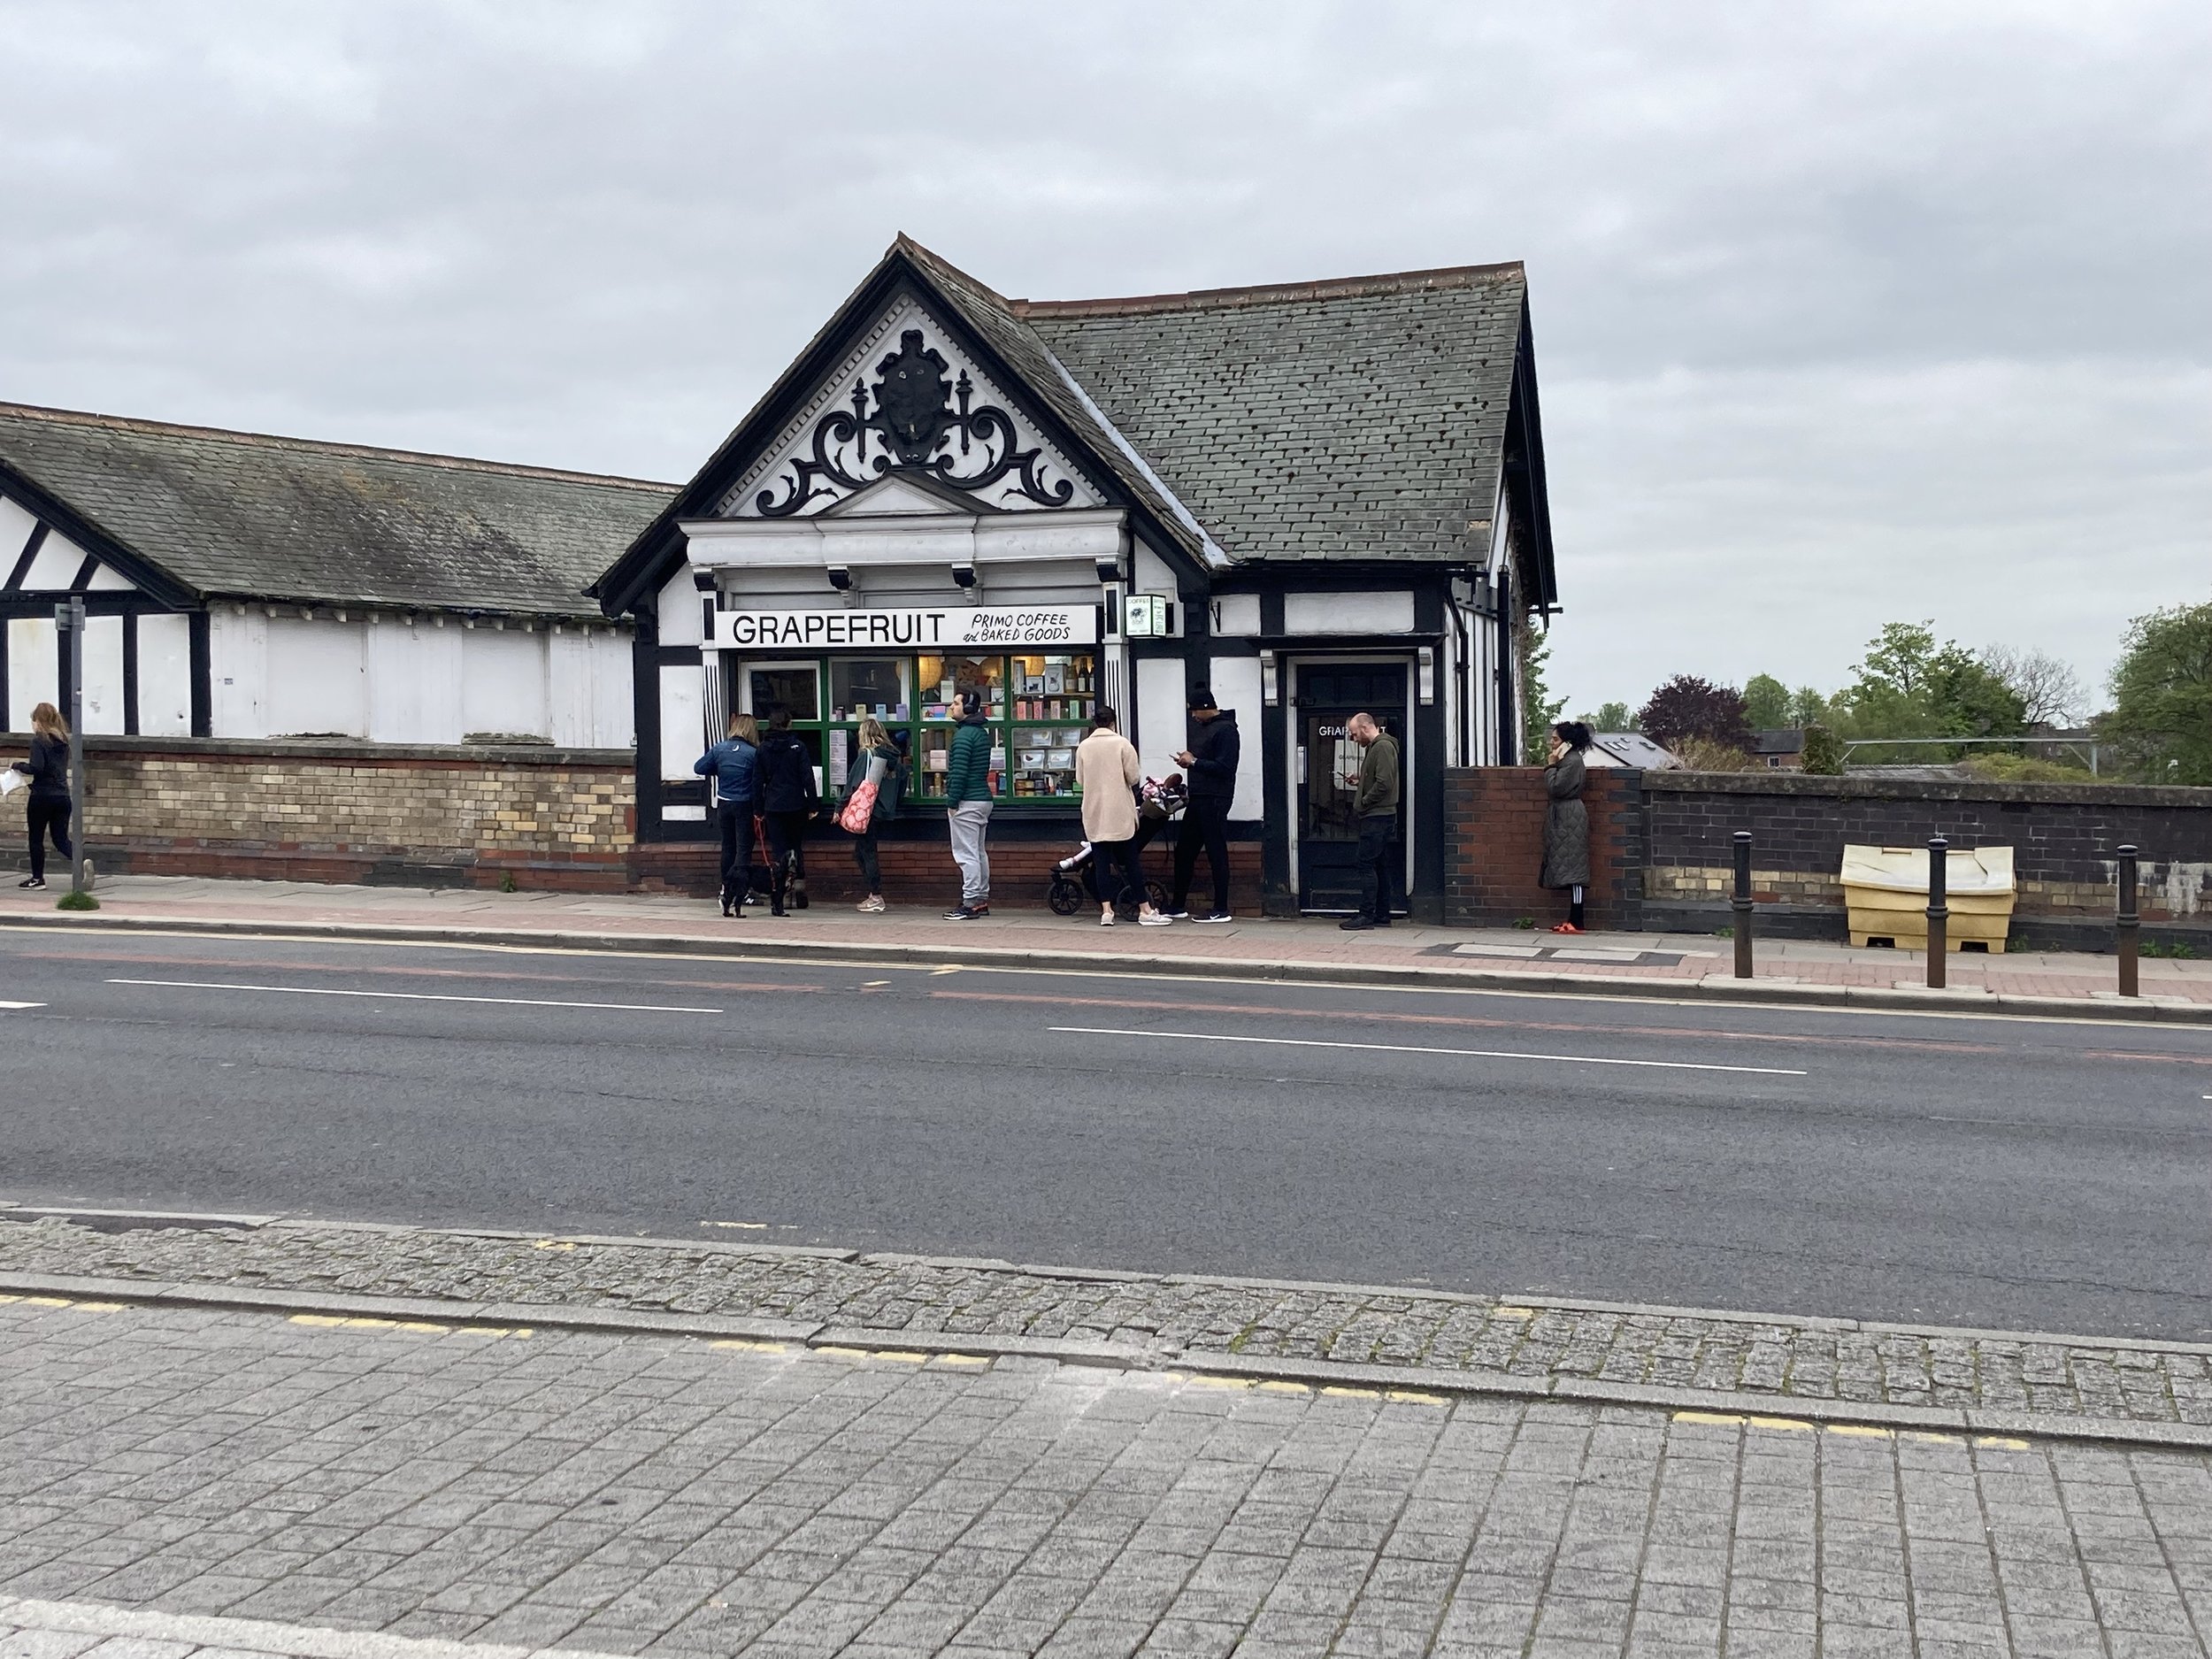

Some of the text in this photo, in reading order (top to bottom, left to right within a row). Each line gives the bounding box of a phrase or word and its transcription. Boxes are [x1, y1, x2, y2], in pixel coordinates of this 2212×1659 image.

[972, 613, 1068, 628] PRIMO COFFEE
[733, 614, 945, 644] GRAPEFRUIT
[963, 626, 1071, 642] and BAKED GOODS
